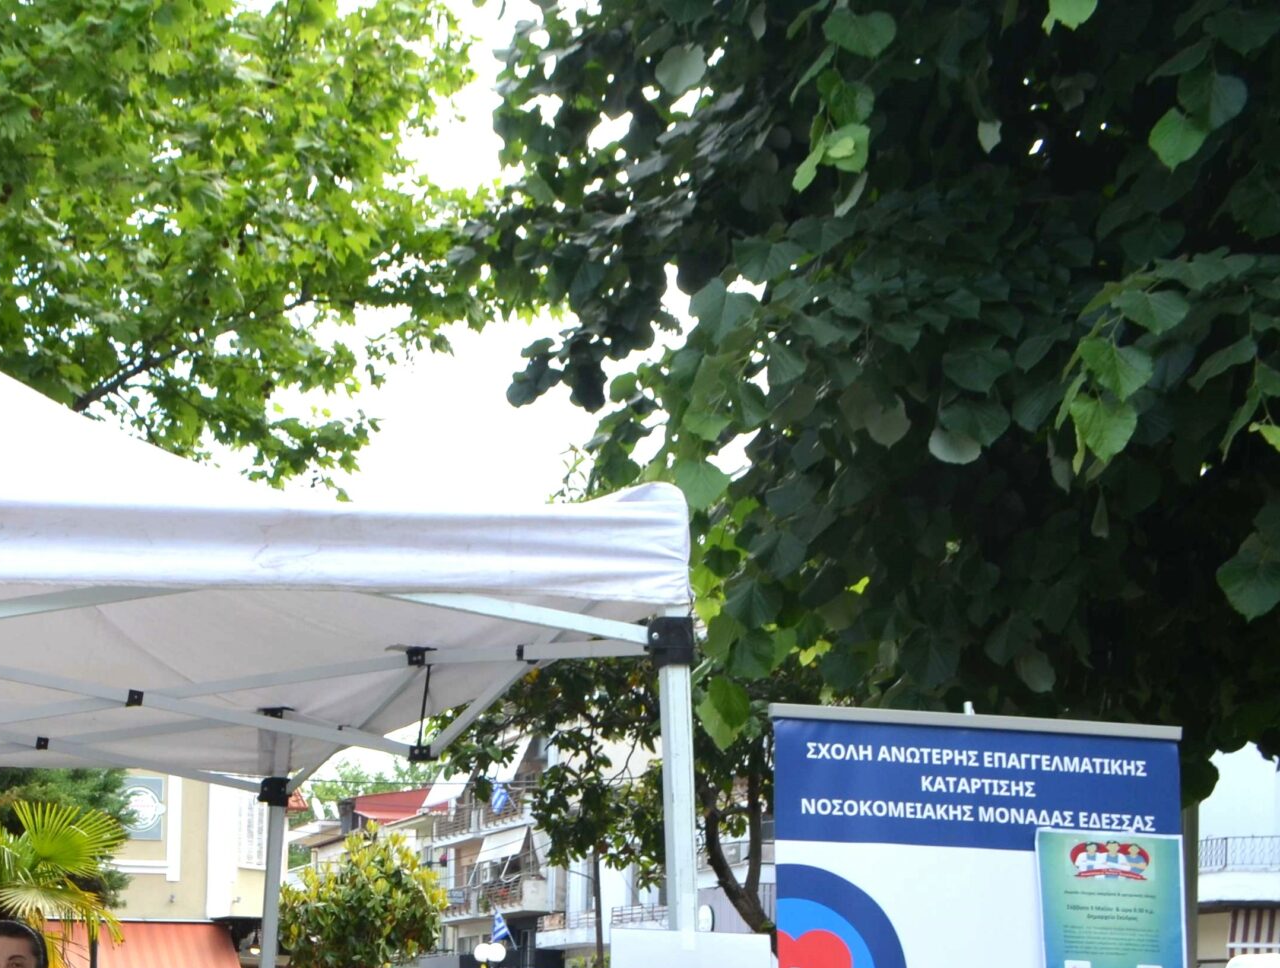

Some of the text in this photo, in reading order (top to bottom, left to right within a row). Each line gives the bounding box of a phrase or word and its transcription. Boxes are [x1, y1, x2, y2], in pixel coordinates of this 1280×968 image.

[806, 742, 1148, 777] ΣΧΟΛΗ ΑΝΩΤΕΡΗΣ ΕΠΑΓΓΕΛΜΑΤΙΚΗΣ
[921, 776, 1037, 798] ΚΑΤΑΡΤΙΣΗΣ
[801, 798, 1157, 832] ΝΟΣΟΚΟΜΕΙΑΚΗΣ ΜΟΝΑΔΑΣ ΕΔΕΣΣΑΣ
